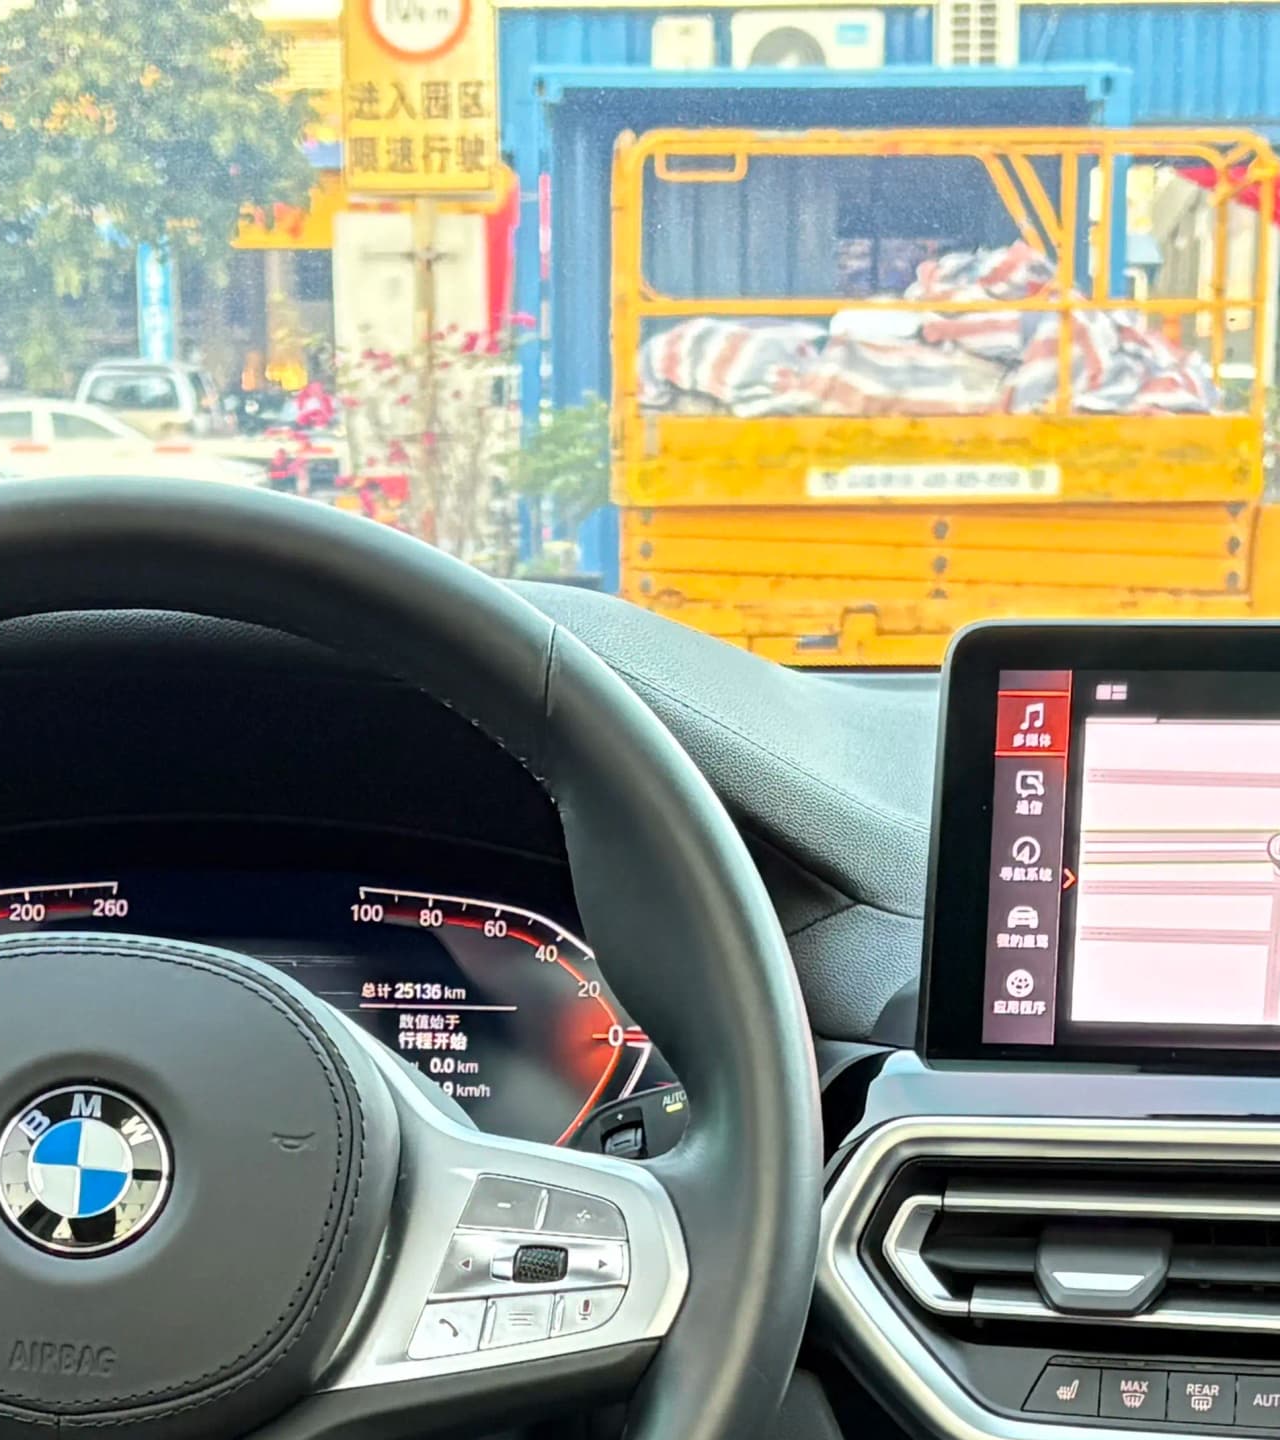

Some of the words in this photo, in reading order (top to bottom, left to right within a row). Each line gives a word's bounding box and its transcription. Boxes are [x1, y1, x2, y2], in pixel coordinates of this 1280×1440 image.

[1012, 733, 1052, 748] 多媒体
[9, 904, 46, 922] 200
[92, 899, 128, 918] 260
[350, 904, 384, 923] 100
[419, 909, 443, 927] 80
[483, 919, 508, 938] 60
[535, 944, 558, 963] 40
[361, 983, 392, 999] 总计
[394, 983, 442, 1000] 25136
[444, 986, 466, 1000] km
[577, 980, 601, 998] 20
[398, 1032, 468, 1050] 行程开始
[608, 1025, 624, 1047] 0
[430, 1058, 455, 1074] 0.0
[457, 1060, 479, 1074] km
[456, 1083, 491, 1097] km/h
[18, 1092, 154, 1147] BMW
[8, 1339, 116, 1377] AIRBAG
[1120, 1379, 1149, 1393] MAX
[1186, 1383, 1220, 1396] REAR
